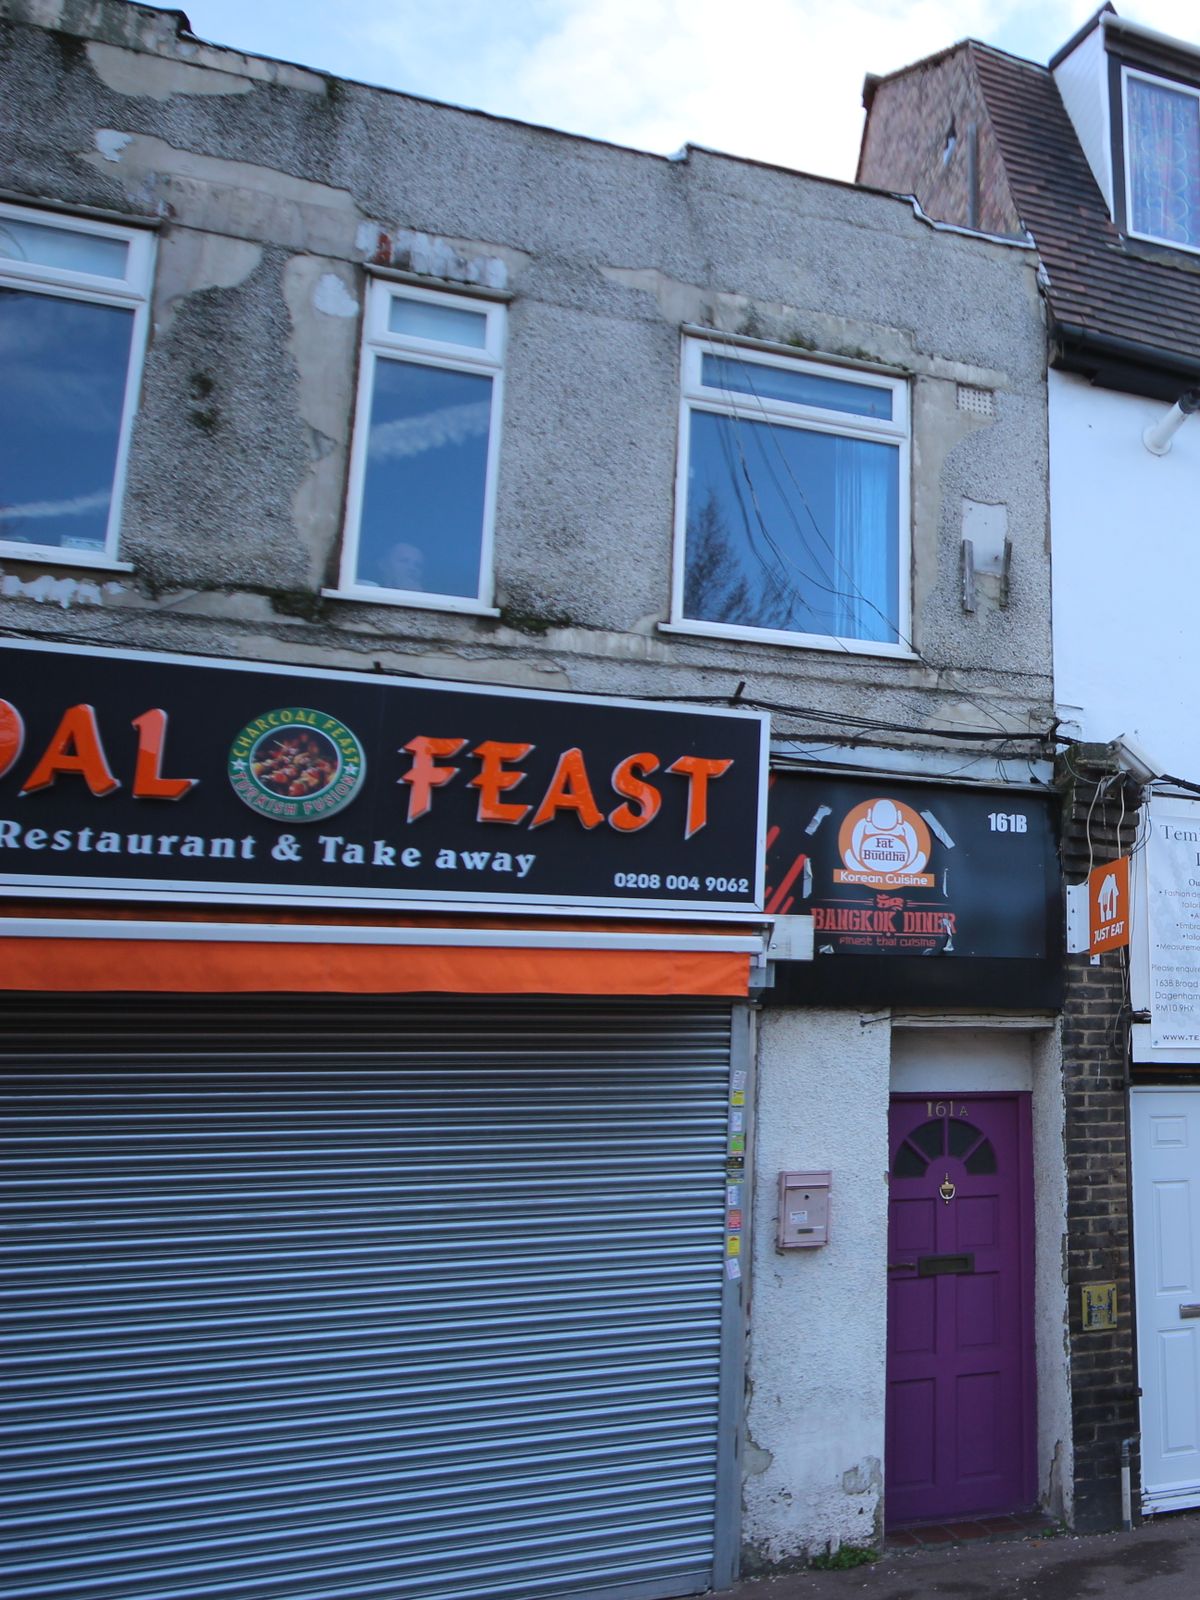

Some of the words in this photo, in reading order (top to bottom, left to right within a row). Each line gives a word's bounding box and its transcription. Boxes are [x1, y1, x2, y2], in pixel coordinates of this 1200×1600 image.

[233, 710, 317, 757] CHARCOAL
[322, 719, 361, 764] FEAST
[230, 772, 298, 816] TURKISH
[302, 774, 357, 815] FUSION
[399, 734, 735, 841] FEAST
[987, 812, 1028, 833] 161B
[0, 820, 256, 861] Restaurant
[271, 835, 303, 861] &
[320, 836, 422, 868] Take
[436, 846, 537, 877] away
[874, 837, 894, 849] Fat
[863, 850, 906, 863] Buddha
[614, 871, 661, 890] 0208
[665, 873, 700, 891] 004
[705, 875, 750, 894] 9062
[839, 871, 884, 885] Korean
[885, 873, 928, 886] Cuisine
[811, 908, 897, 933] BANGKOK
[903, 912, 957, 934] DINER
[1093, 925, 1110, 945] JUST
[1110, 920, 1125, 939] EAT
[1175, 979, 1199, 988] Broad
